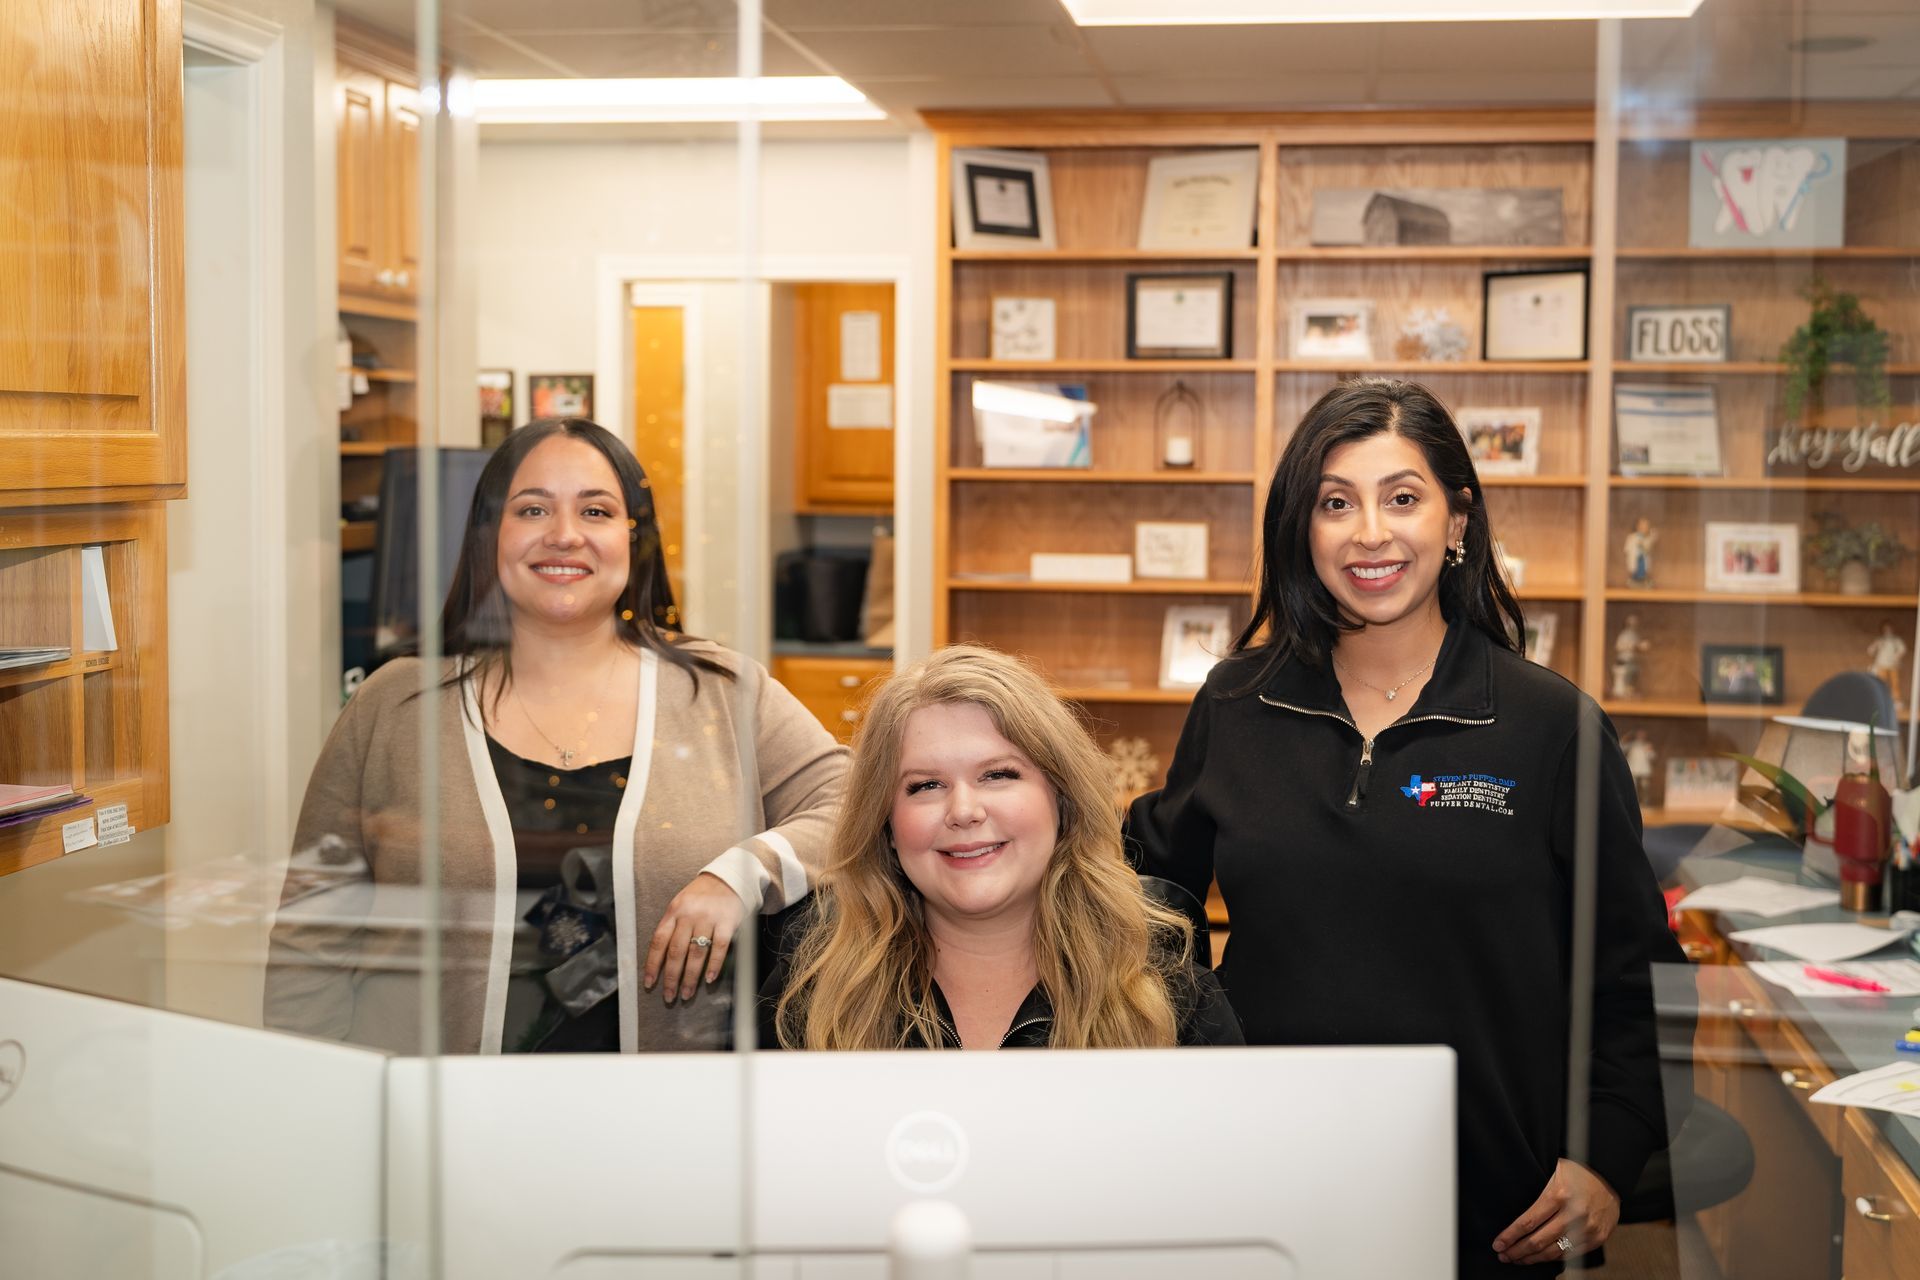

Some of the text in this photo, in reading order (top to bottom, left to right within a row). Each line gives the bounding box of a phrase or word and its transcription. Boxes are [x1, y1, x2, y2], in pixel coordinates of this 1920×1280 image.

[1638, 317, 1720, 354] FLOSS
[1440, 780, 1510, 794] IMPLANT DENTISTRY
[1469, 774, 1497, 782] PUFFER
[1498, 778, 1516, 787] DMD
[1469, 787, 1505, 800] DENTISTRY
[1472, 794, 1507, 806] DENTISTRY
[1463, 800, 1514, 816] DENTAL.COM
